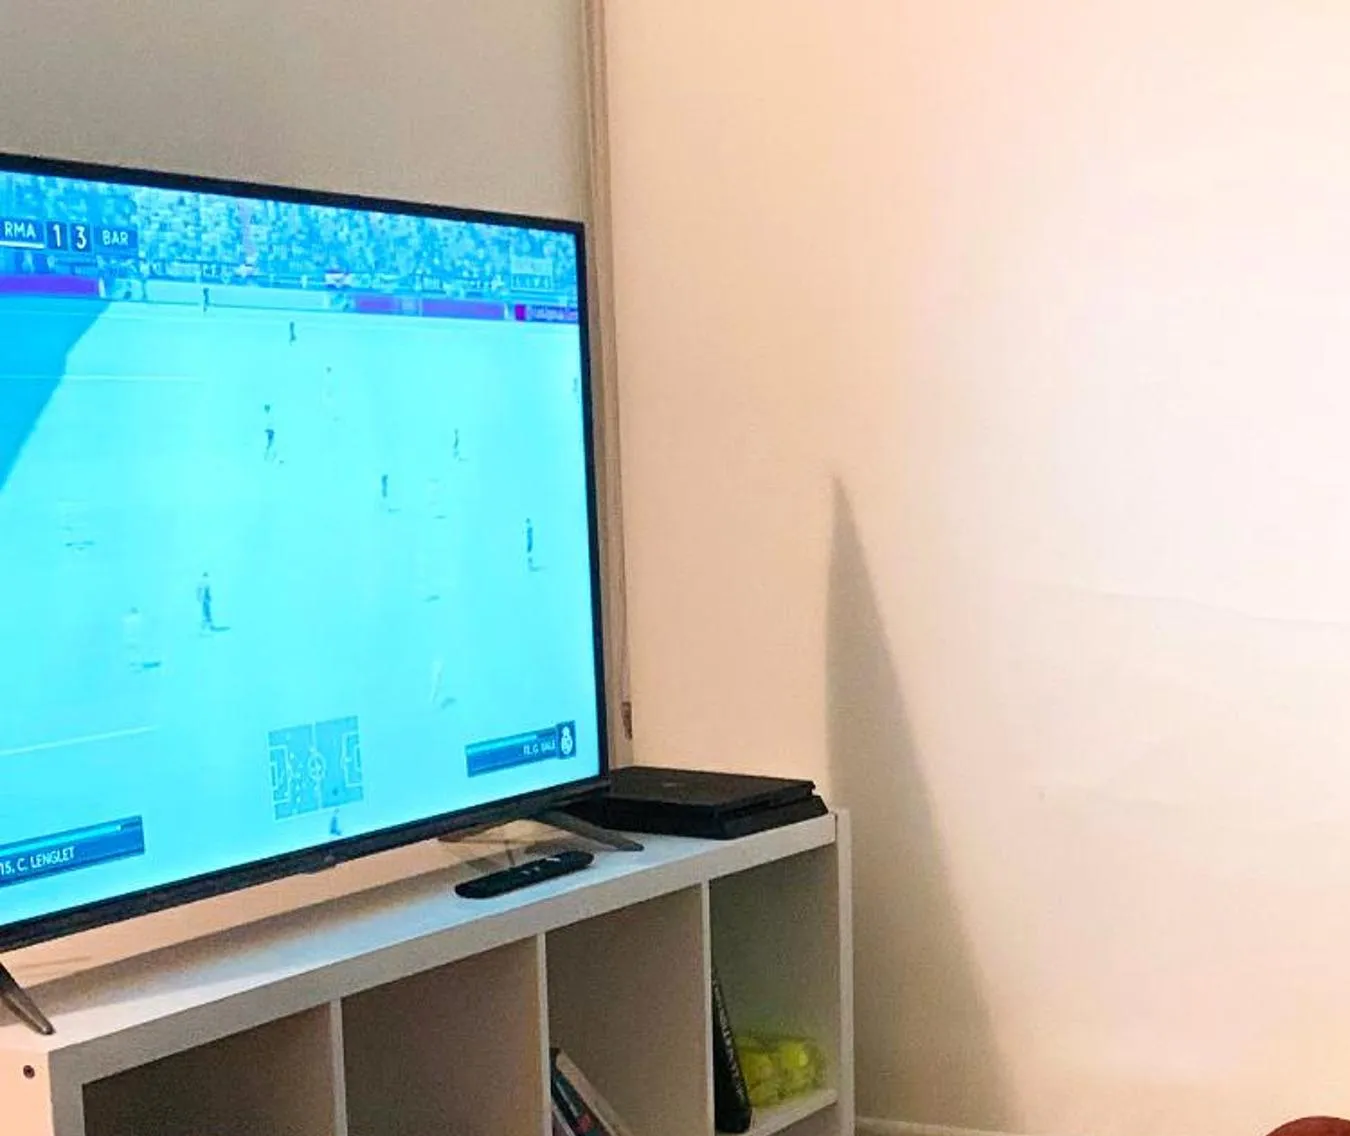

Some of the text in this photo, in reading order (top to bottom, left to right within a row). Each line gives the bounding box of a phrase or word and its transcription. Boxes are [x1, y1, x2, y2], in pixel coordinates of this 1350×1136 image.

[3, 221, 129, 250] RMA 1 3 BAR
[30, 846, 75, 869] LENGLET
